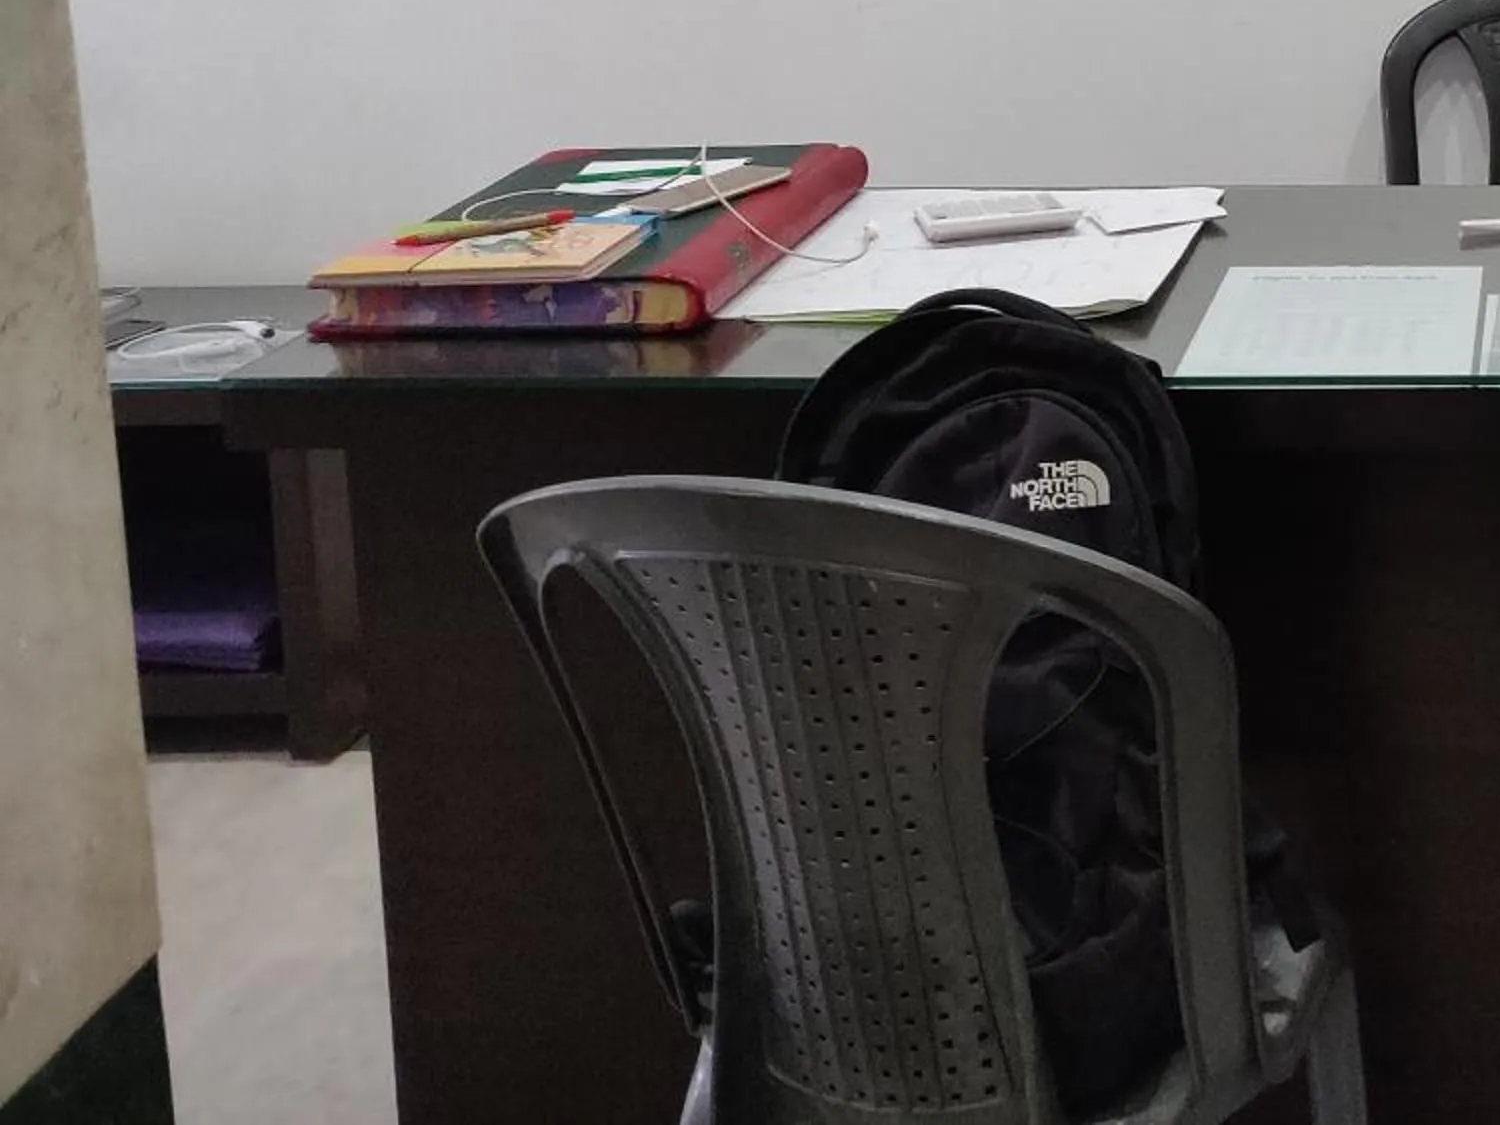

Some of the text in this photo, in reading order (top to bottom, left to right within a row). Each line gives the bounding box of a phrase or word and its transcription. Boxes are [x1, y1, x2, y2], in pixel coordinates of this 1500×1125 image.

[1038, 461, 1078, 477] THE
[1010, 477, 1077, 499] NORTH
[1029, 493, 1078, 511] FACE
